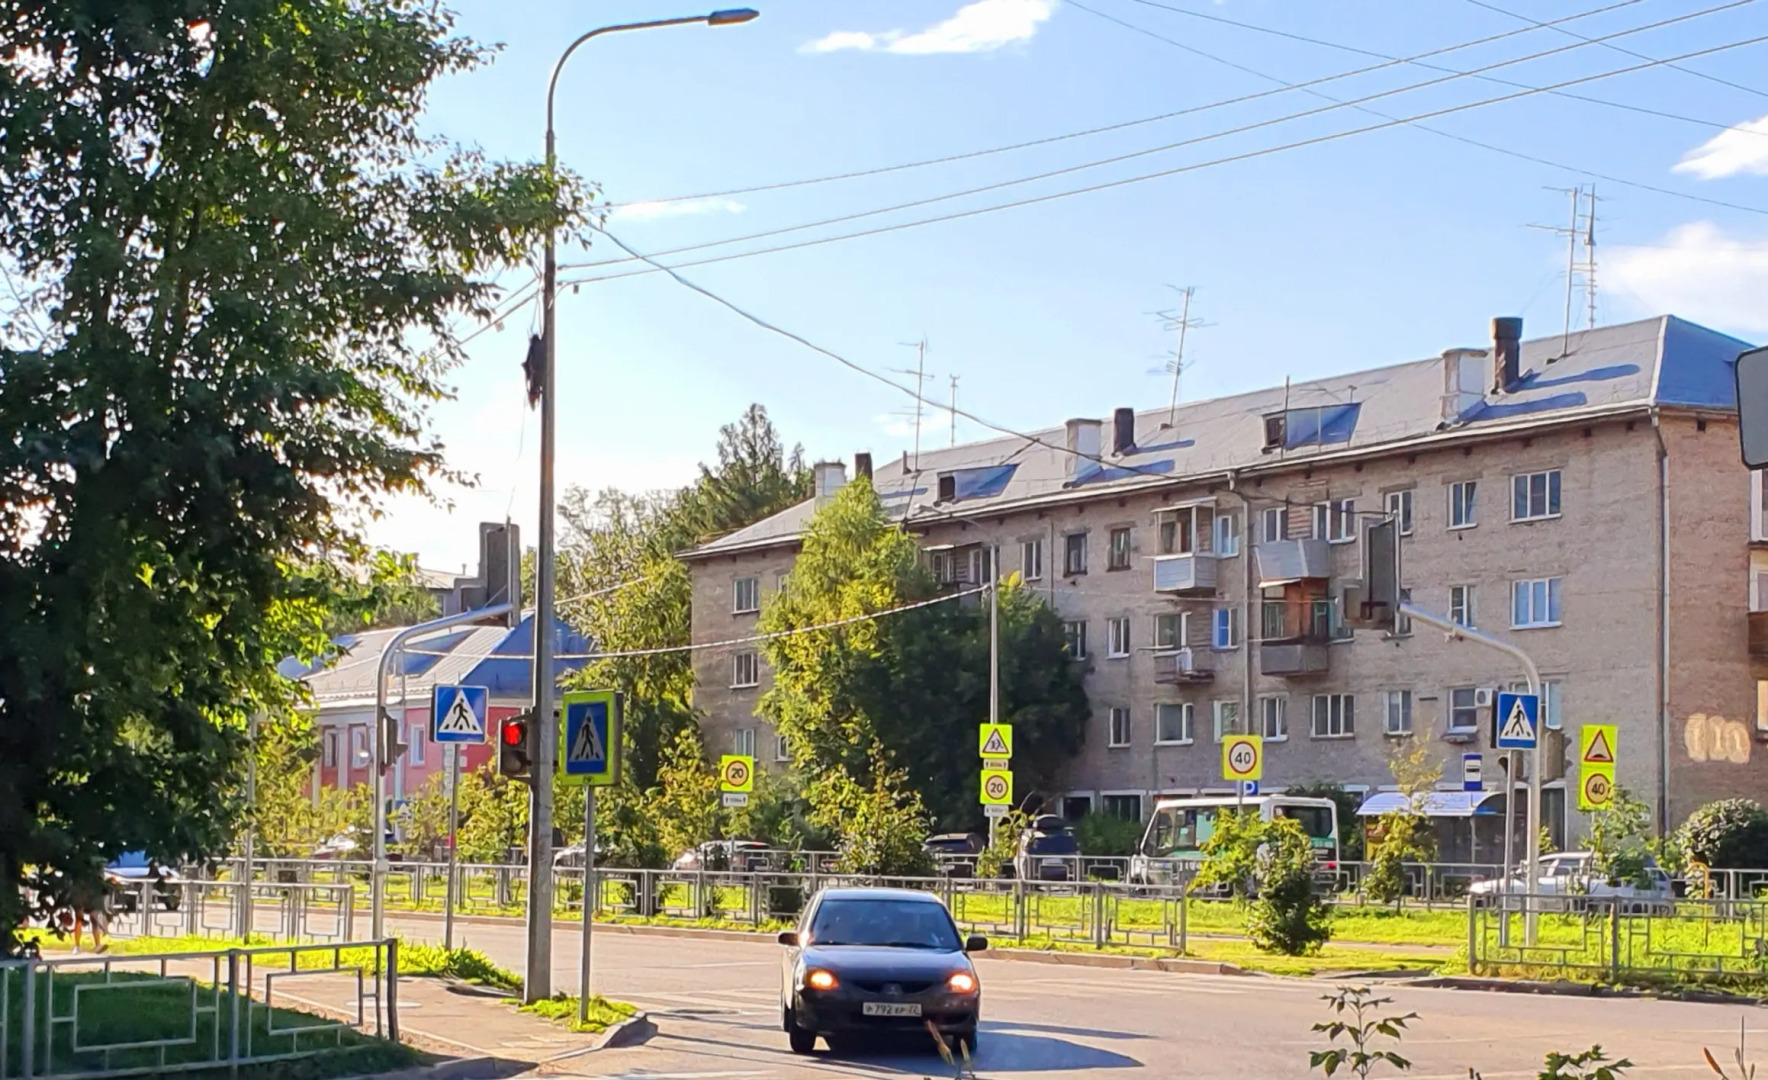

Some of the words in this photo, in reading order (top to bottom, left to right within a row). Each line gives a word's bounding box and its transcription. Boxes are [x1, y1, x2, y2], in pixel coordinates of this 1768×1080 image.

[1234, 751, 1251, 765] 40
[731, 767, 744, 779] 20
[990, 782, 1004, 794] 20
[1591, 782, 1605, 795] 40
